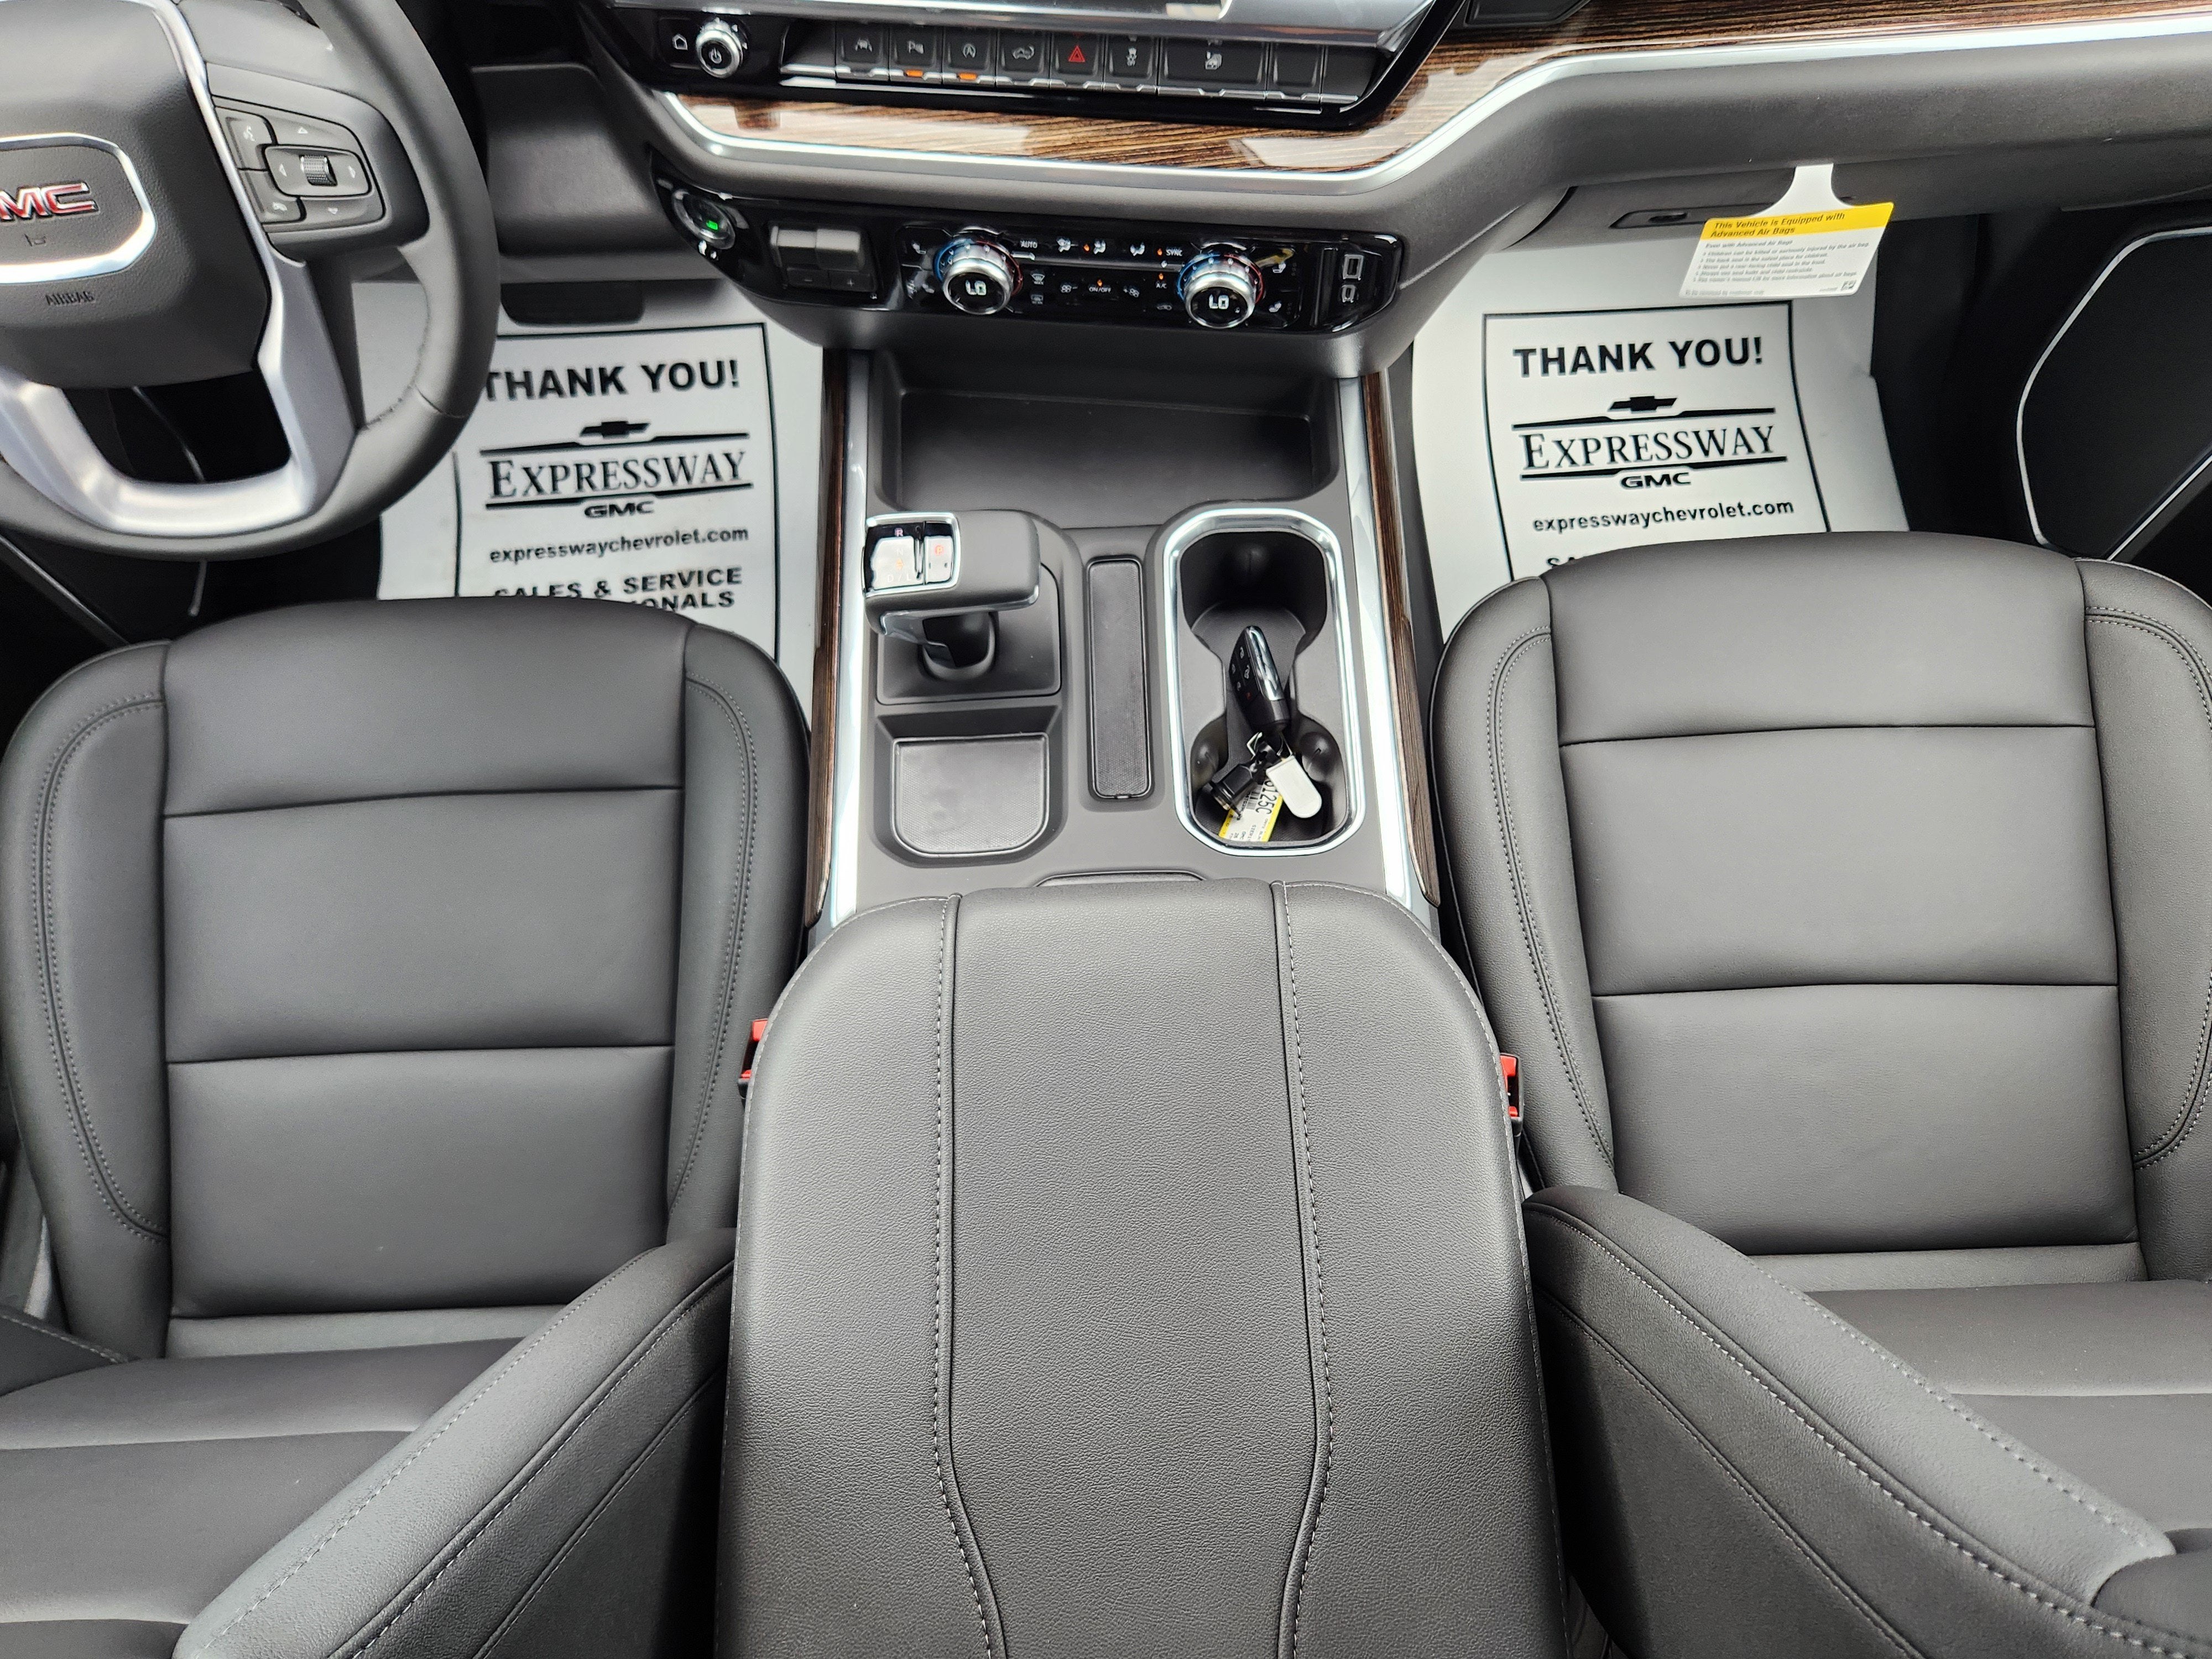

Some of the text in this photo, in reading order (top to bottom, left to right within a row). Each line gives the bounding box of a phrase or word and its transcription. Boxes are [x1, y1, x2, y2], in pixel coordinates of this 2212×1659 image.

[1781, 215, 1823, 226] Equipped
[1710, 229, 1754, 238] Advanced
[1020, 240, 1038, 248] AUTO
[45, 291, 95, 305] AIRBAG
[1514, 336, 1763, 377] THANK YOU!
[486, 359, 739, 401] THANK YOU!
[1620, 471, 1691, 489] GMC
[584, 501, 655, 519] GMC
[1532, 499, 1794, 534] expresswaychevrolet.com
[895, 528, 904, 536] R
[490, 526, 749, 564] expresswaychevrolet.com
[936, 545, 944, 555] P
[593, 580, 611, 598] &
[623, 567, 742, 594] SERVICE
